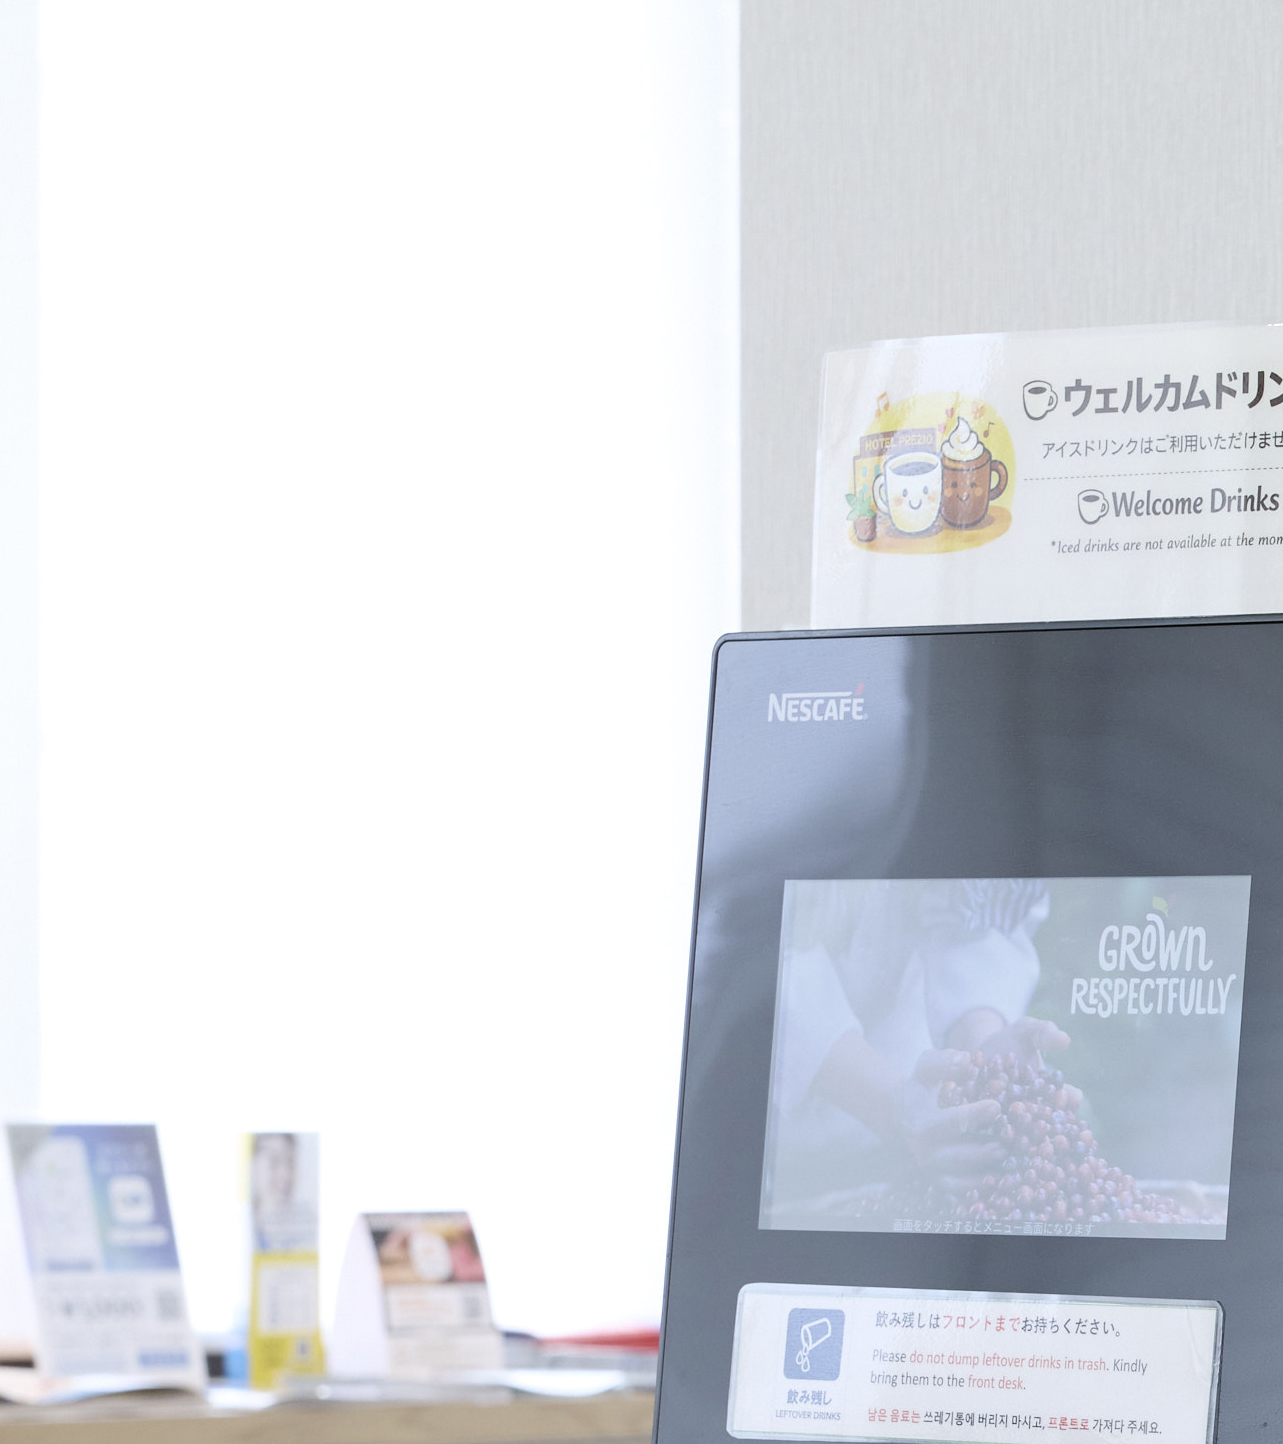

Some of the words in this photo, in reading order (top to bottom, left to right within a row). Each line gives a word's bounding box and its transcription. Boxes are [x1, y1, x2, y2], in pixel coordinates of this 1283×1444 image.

[865, 437, 896, 451] HOTEL
[1111, 489, 1203, 518] Welcome
[1210, 485, 1280, 513] Drinks
[1084, 537, 1119, 553] drinks
[1123, 541, 1141, 551] are
[1145, 539, 1163, 550] not
[1167, 534, 1217, 549] available
[1220, 536, 1232, 547] at
[1236, 533, 1254, 546] the
[1070, 974, 1237, 1019] RESPECTFULLY
[875, 1310, 1122, 1338] 飲み残しはフロントまでお持ちください。
[872, 1348, 907, 1363] Please
[909, 1349, 924, 1363] do
[926, 1351, 946, 1364] not
[948, 1350, 980, 1368] dump
[982, 1352, 1026, 1367] leftover
[1028, 1354, 1062, 1369] drinks
[1064, 1355, 1075, 1369] in
[1077, 1356, 1110, 1371] trash.
[1113, 1358, 1148, 1375] Kindly
[870, 1371, 898, 1388] bring
[901, 1372, 930, 1387] them
[932, 1374, 944, 1387] to
[947, 1374, 965, 1388] the
[968, 1375, 995, 1389] front
[998, 1376, 1026, 1390] desk.
[786, 1389, 832, 1405] 飲み残し
[775, 1410, 812, 1419] LEFTOVER
[813, 1412, 842, 1421] DRINKS
[867, 1408, 888, 1422] 남은
[890, 1409, 921, 1424] 음료는
[923, 1410, 975, 1427] 쓰레기통에
[977, 1413, 1009, 1429] 버리지
[1011, 1415, 1046, 1431] 마시고,
[1047, 1416, 1090, 1431] 프론트로
[1092, 1418, 1125, 1434] 가져다
[1127, 1420, 1162, 1435] 주세요.
